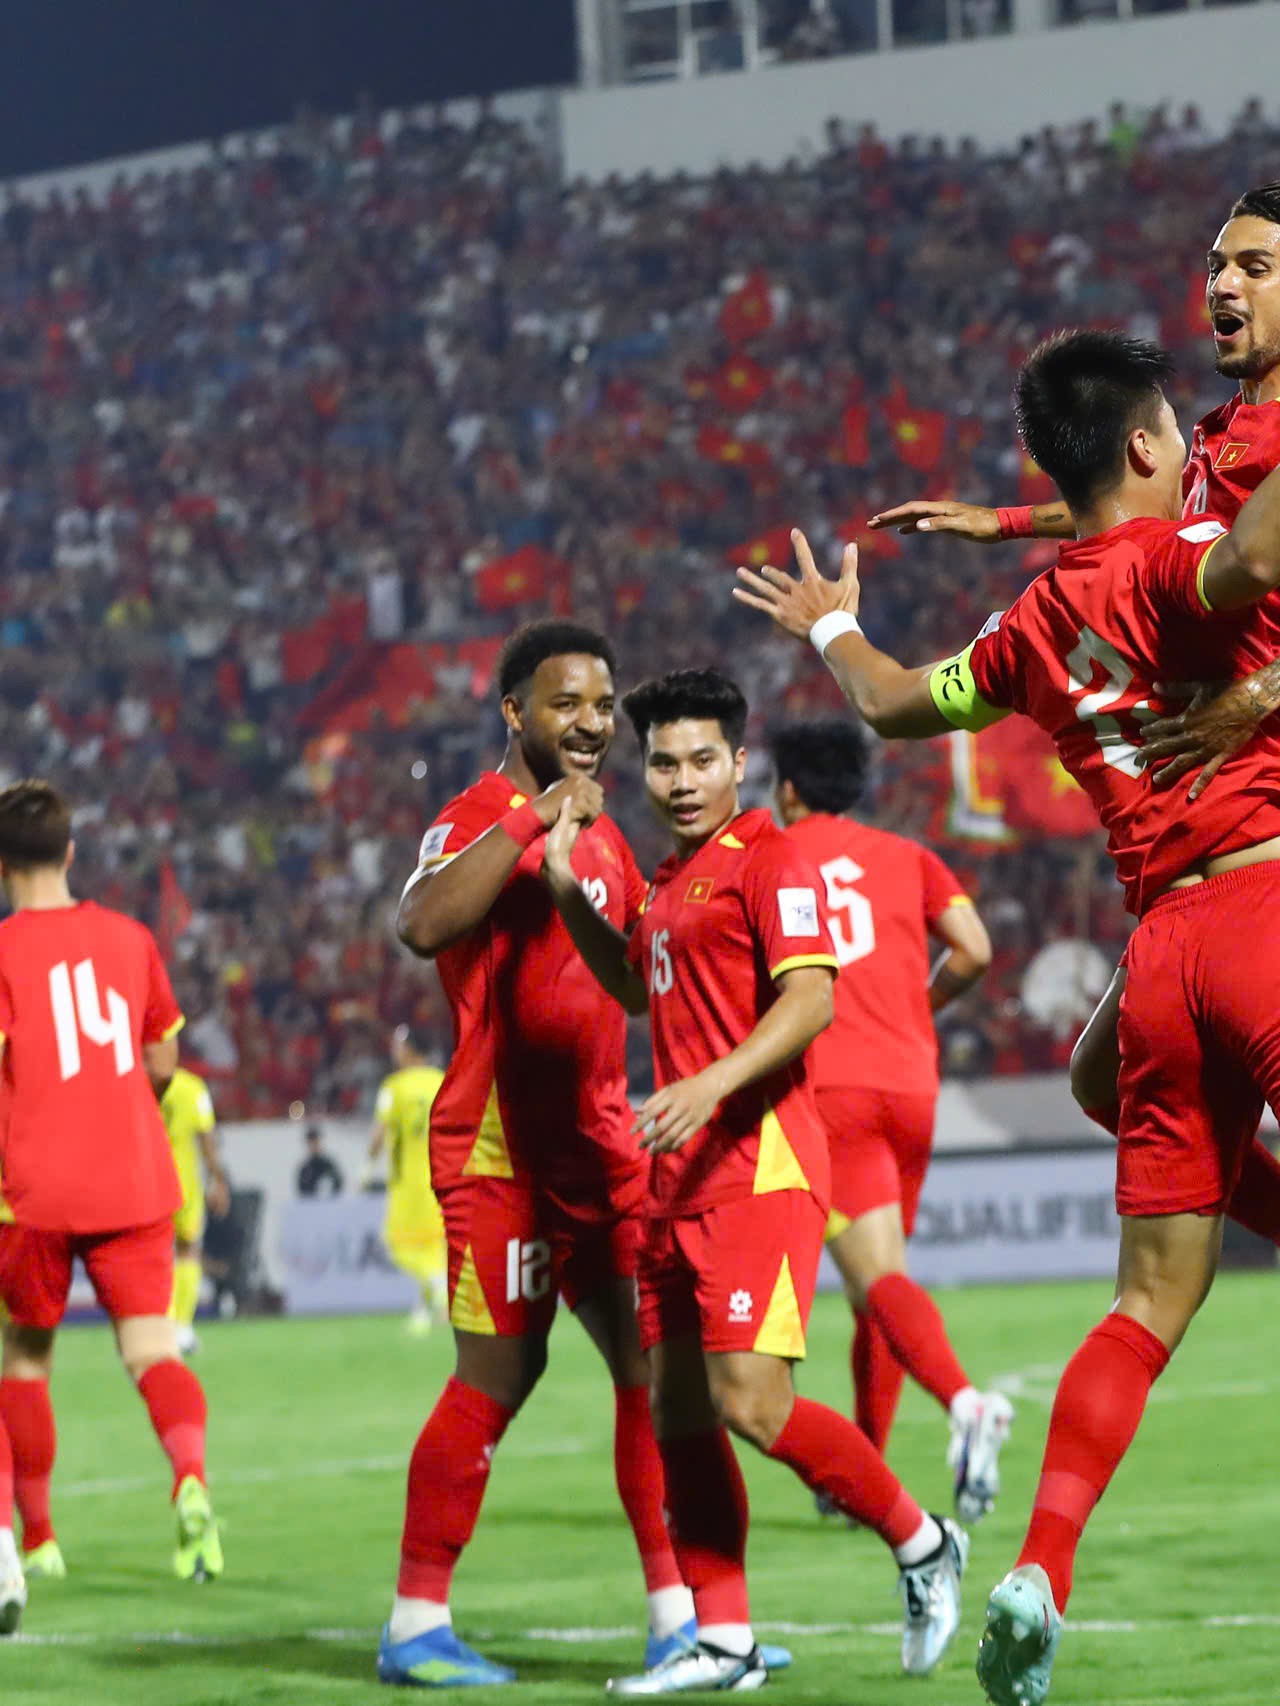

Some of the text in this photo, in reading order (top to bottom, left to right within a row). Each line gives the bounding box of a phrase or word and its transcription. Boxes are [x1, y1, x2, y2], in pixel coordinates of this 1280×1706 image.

[941, 655, 965, 702] FC
[650, 928, 673, 997] 15
[48, 956, 135, 1083] 14
[506, 1238, 551, 1304] 12
